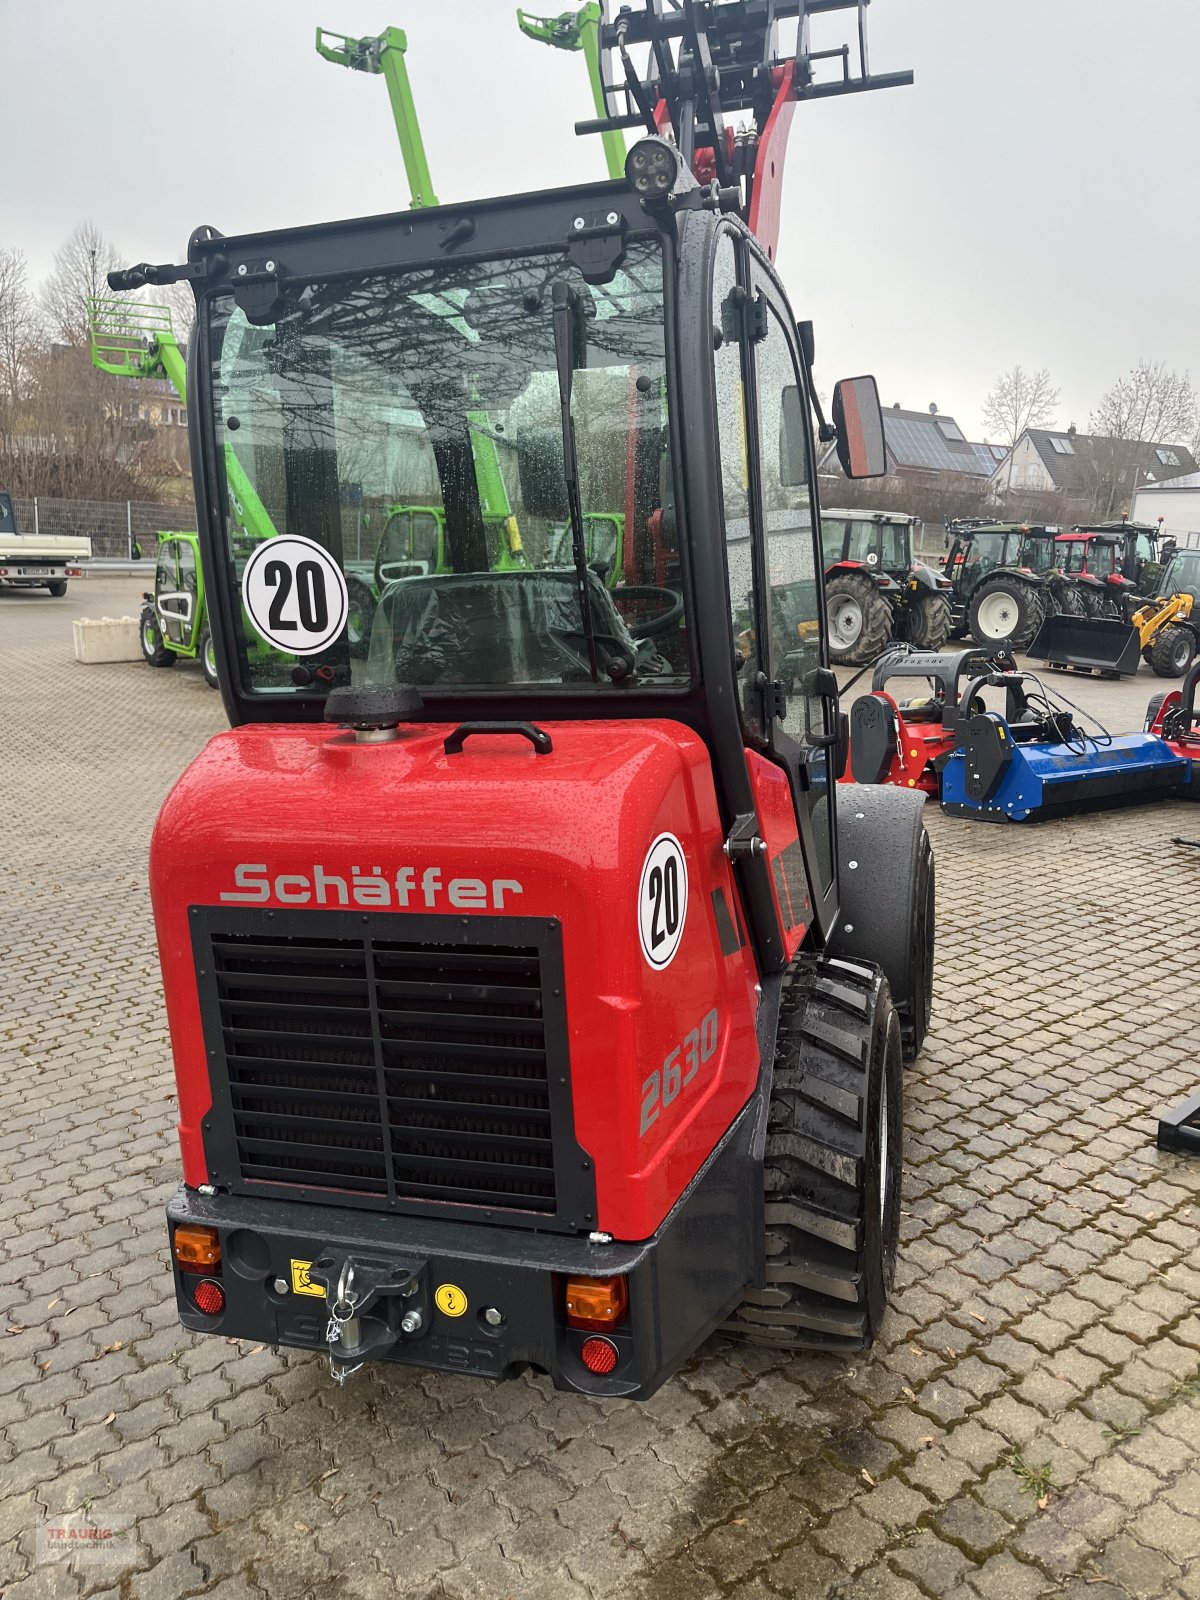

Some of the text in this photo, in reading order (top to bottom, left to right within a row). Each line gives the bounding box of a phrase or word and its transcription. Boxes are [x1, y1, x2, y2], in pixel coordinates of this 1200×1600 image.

[264, 560, 329, 633] 20
[219, 863, 523, 909] Schäffer
[649, 855, 679, 950] 20
[639, 1007, 718, 1137] 2630
